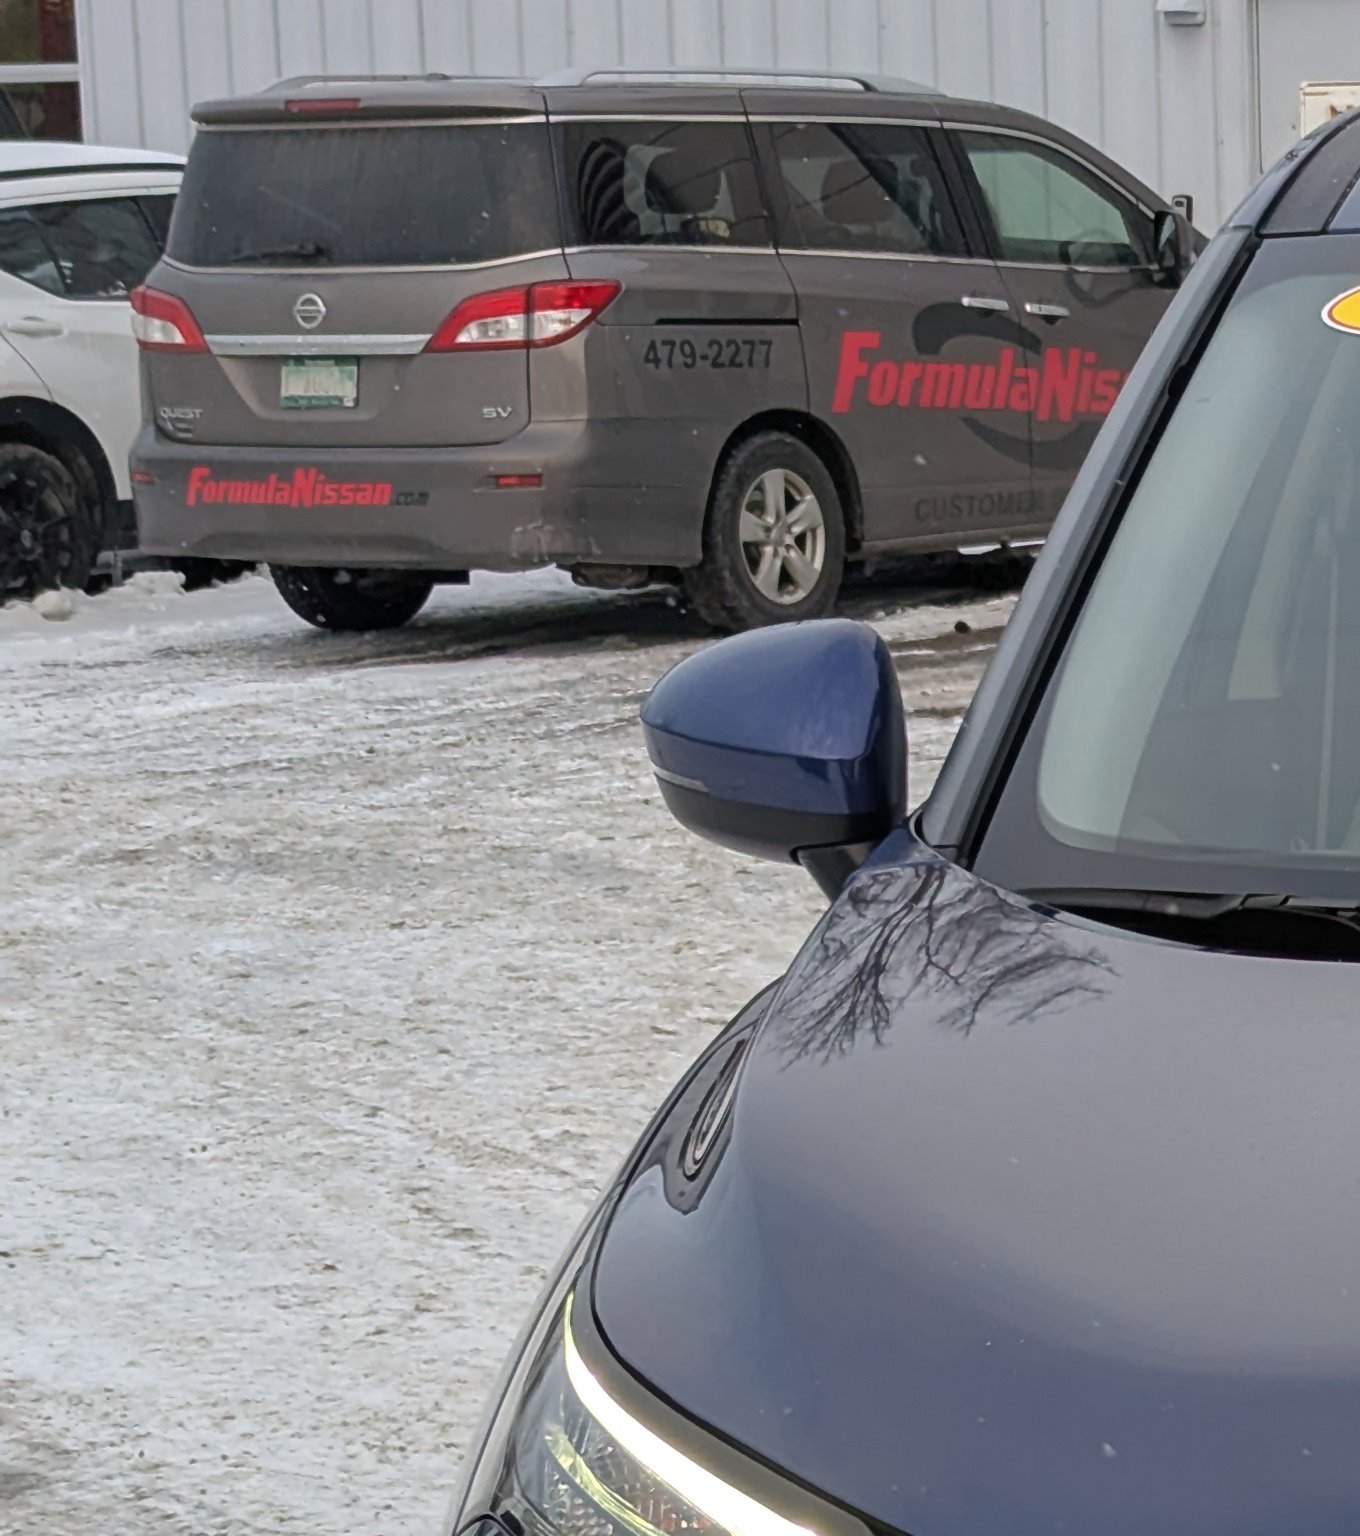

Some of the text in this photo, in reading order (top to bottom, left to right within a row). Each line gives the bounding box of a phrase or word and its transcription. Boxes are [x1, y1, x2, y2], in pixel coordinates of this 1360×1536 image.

[643, 338, 774, 371] 479-2277
[831, 330, 1130, 422] FormulaNis
[159, 407, 203, 419] QUEST
[482, 406, 513, 418] SV
